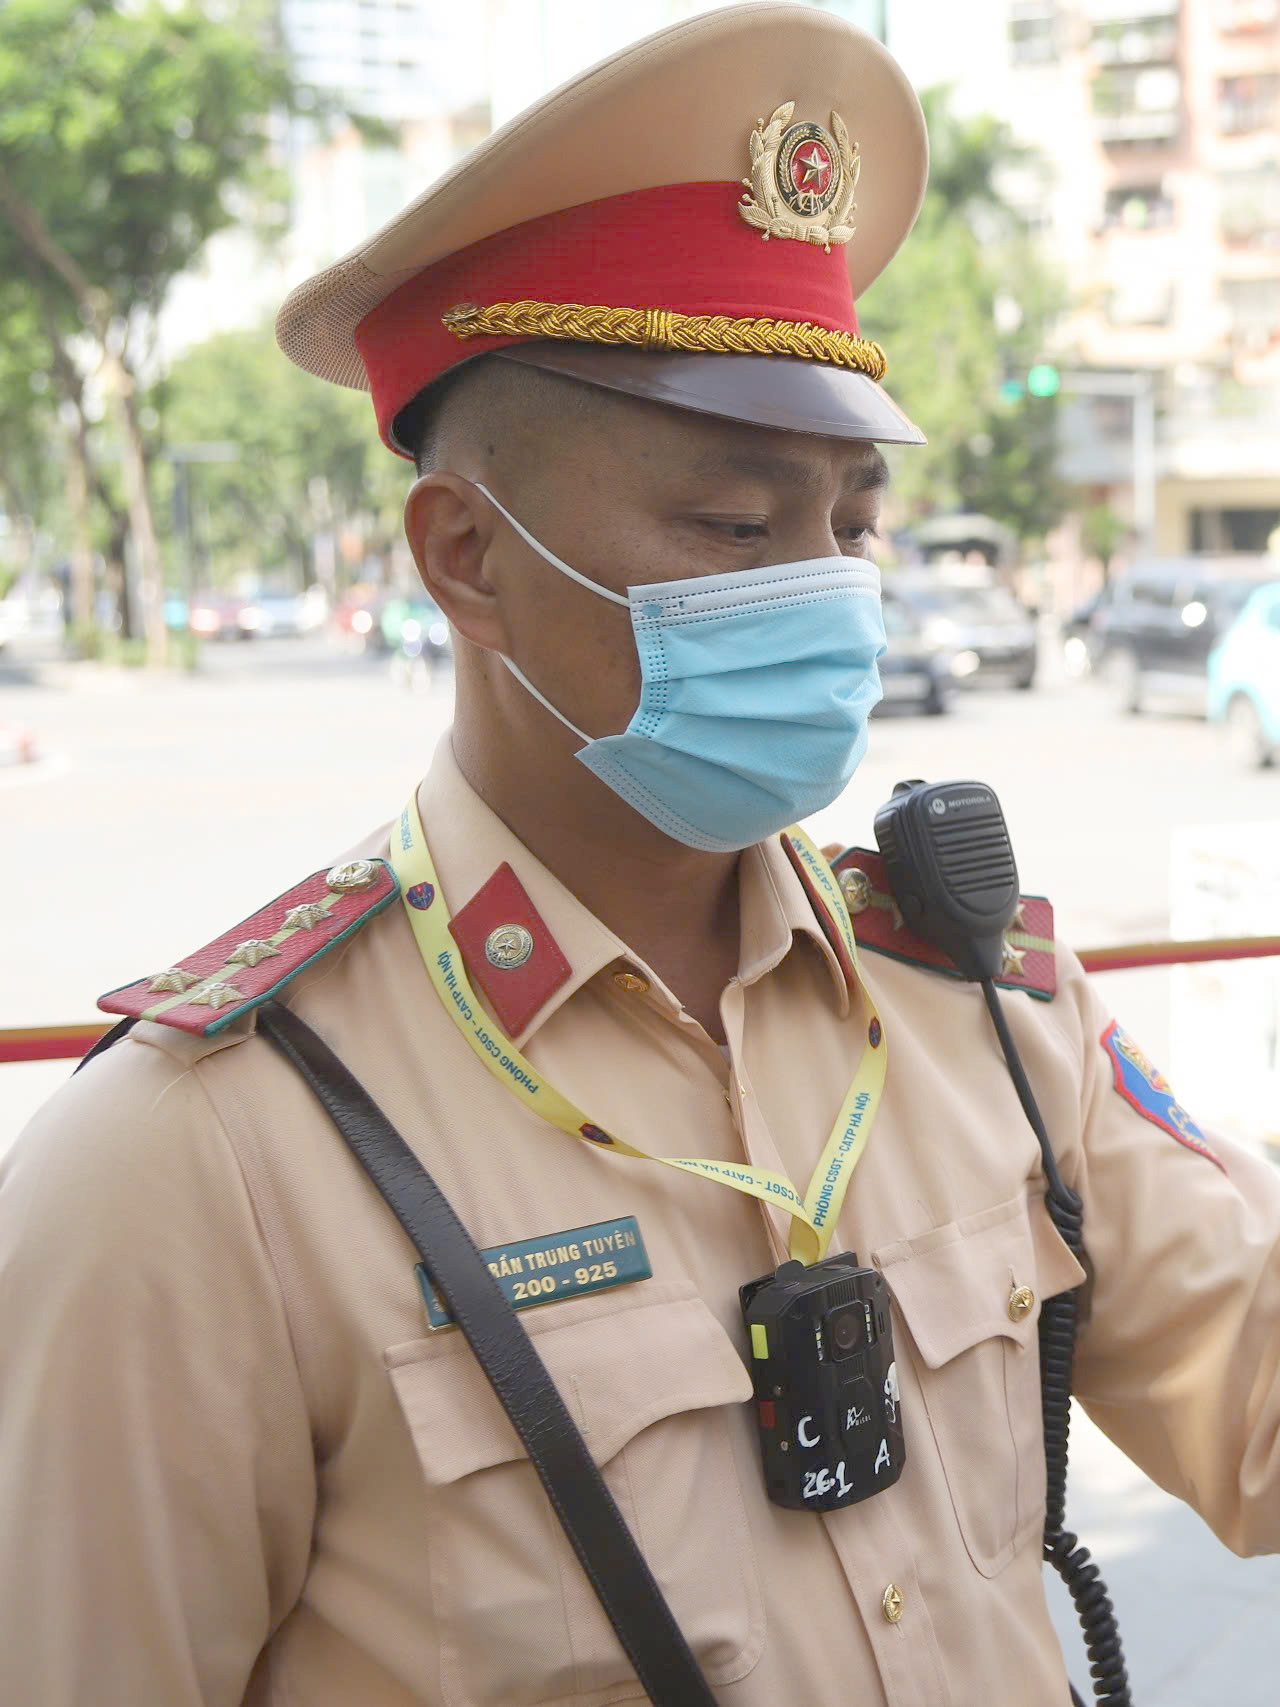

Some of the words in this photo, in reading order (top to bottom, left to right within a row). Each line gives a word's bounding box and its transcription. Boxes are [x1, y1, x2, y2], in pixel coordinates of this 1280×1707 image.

[948, 796, 991, 808] MOTOROLA
[811, 864, 833, 892] CATP
[437, 951, 453, 974] NỘI
[443, 972, 457, 991] HÀ
[452, 990, 473, 1021] CATP
[475, 1027, 501, 1058] CSGT
[499, 1055, 539, 1094] PHÒNG
[813, 1184, 834, 1227] PHÒNG
[826, 1158, 844, 1184] CSGT
[838, 1128, 857, 1152] CATP
[849, 1113, 863, 1128] HÀ
[856, 1092, 871, 1111] NỘI
[722, 1170, 754, 1185] CATP
[765, 1181, 795, 1201] CSGT
[488, 1253, 523, 1279] RẦN
[525, 1244, 581, 1270] TRUNG
[582, 1230, 636, 1257] TUYÊN
[512, 1275, 556, 1301] 200
[574, 1260, 618, 1285] 925
[798, 1416, 820, 1448] C
[874, 1438, 891, 1475] A
